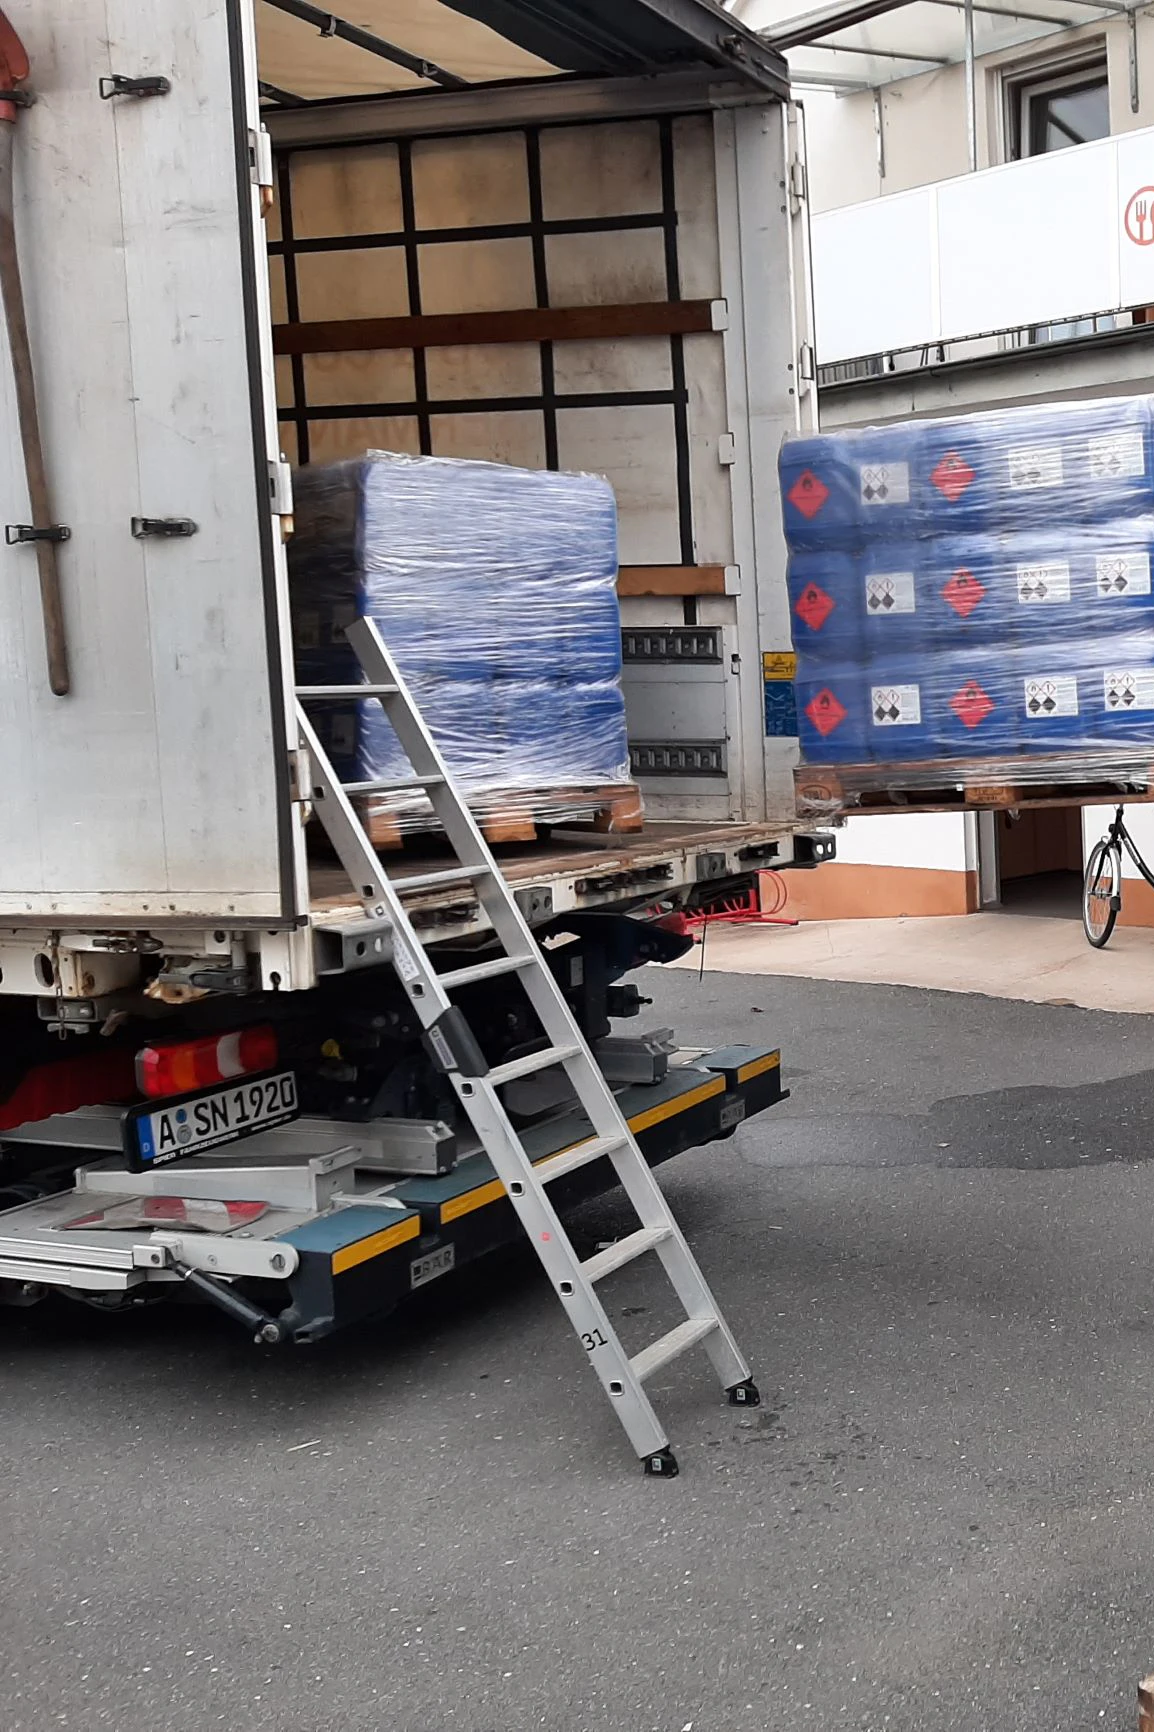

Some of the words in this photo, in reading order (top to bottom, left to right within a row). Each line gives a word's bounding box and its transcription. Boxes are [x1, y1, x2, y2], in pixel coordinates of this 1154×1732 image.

[159, 1114, 176, 1150] A
[193, 1095, 230, 1137] SN
[234, 1076, 295, 1123] 1920
[143, 1142, 150, 1153] D
[581, 1328, 608, 1351] 31
